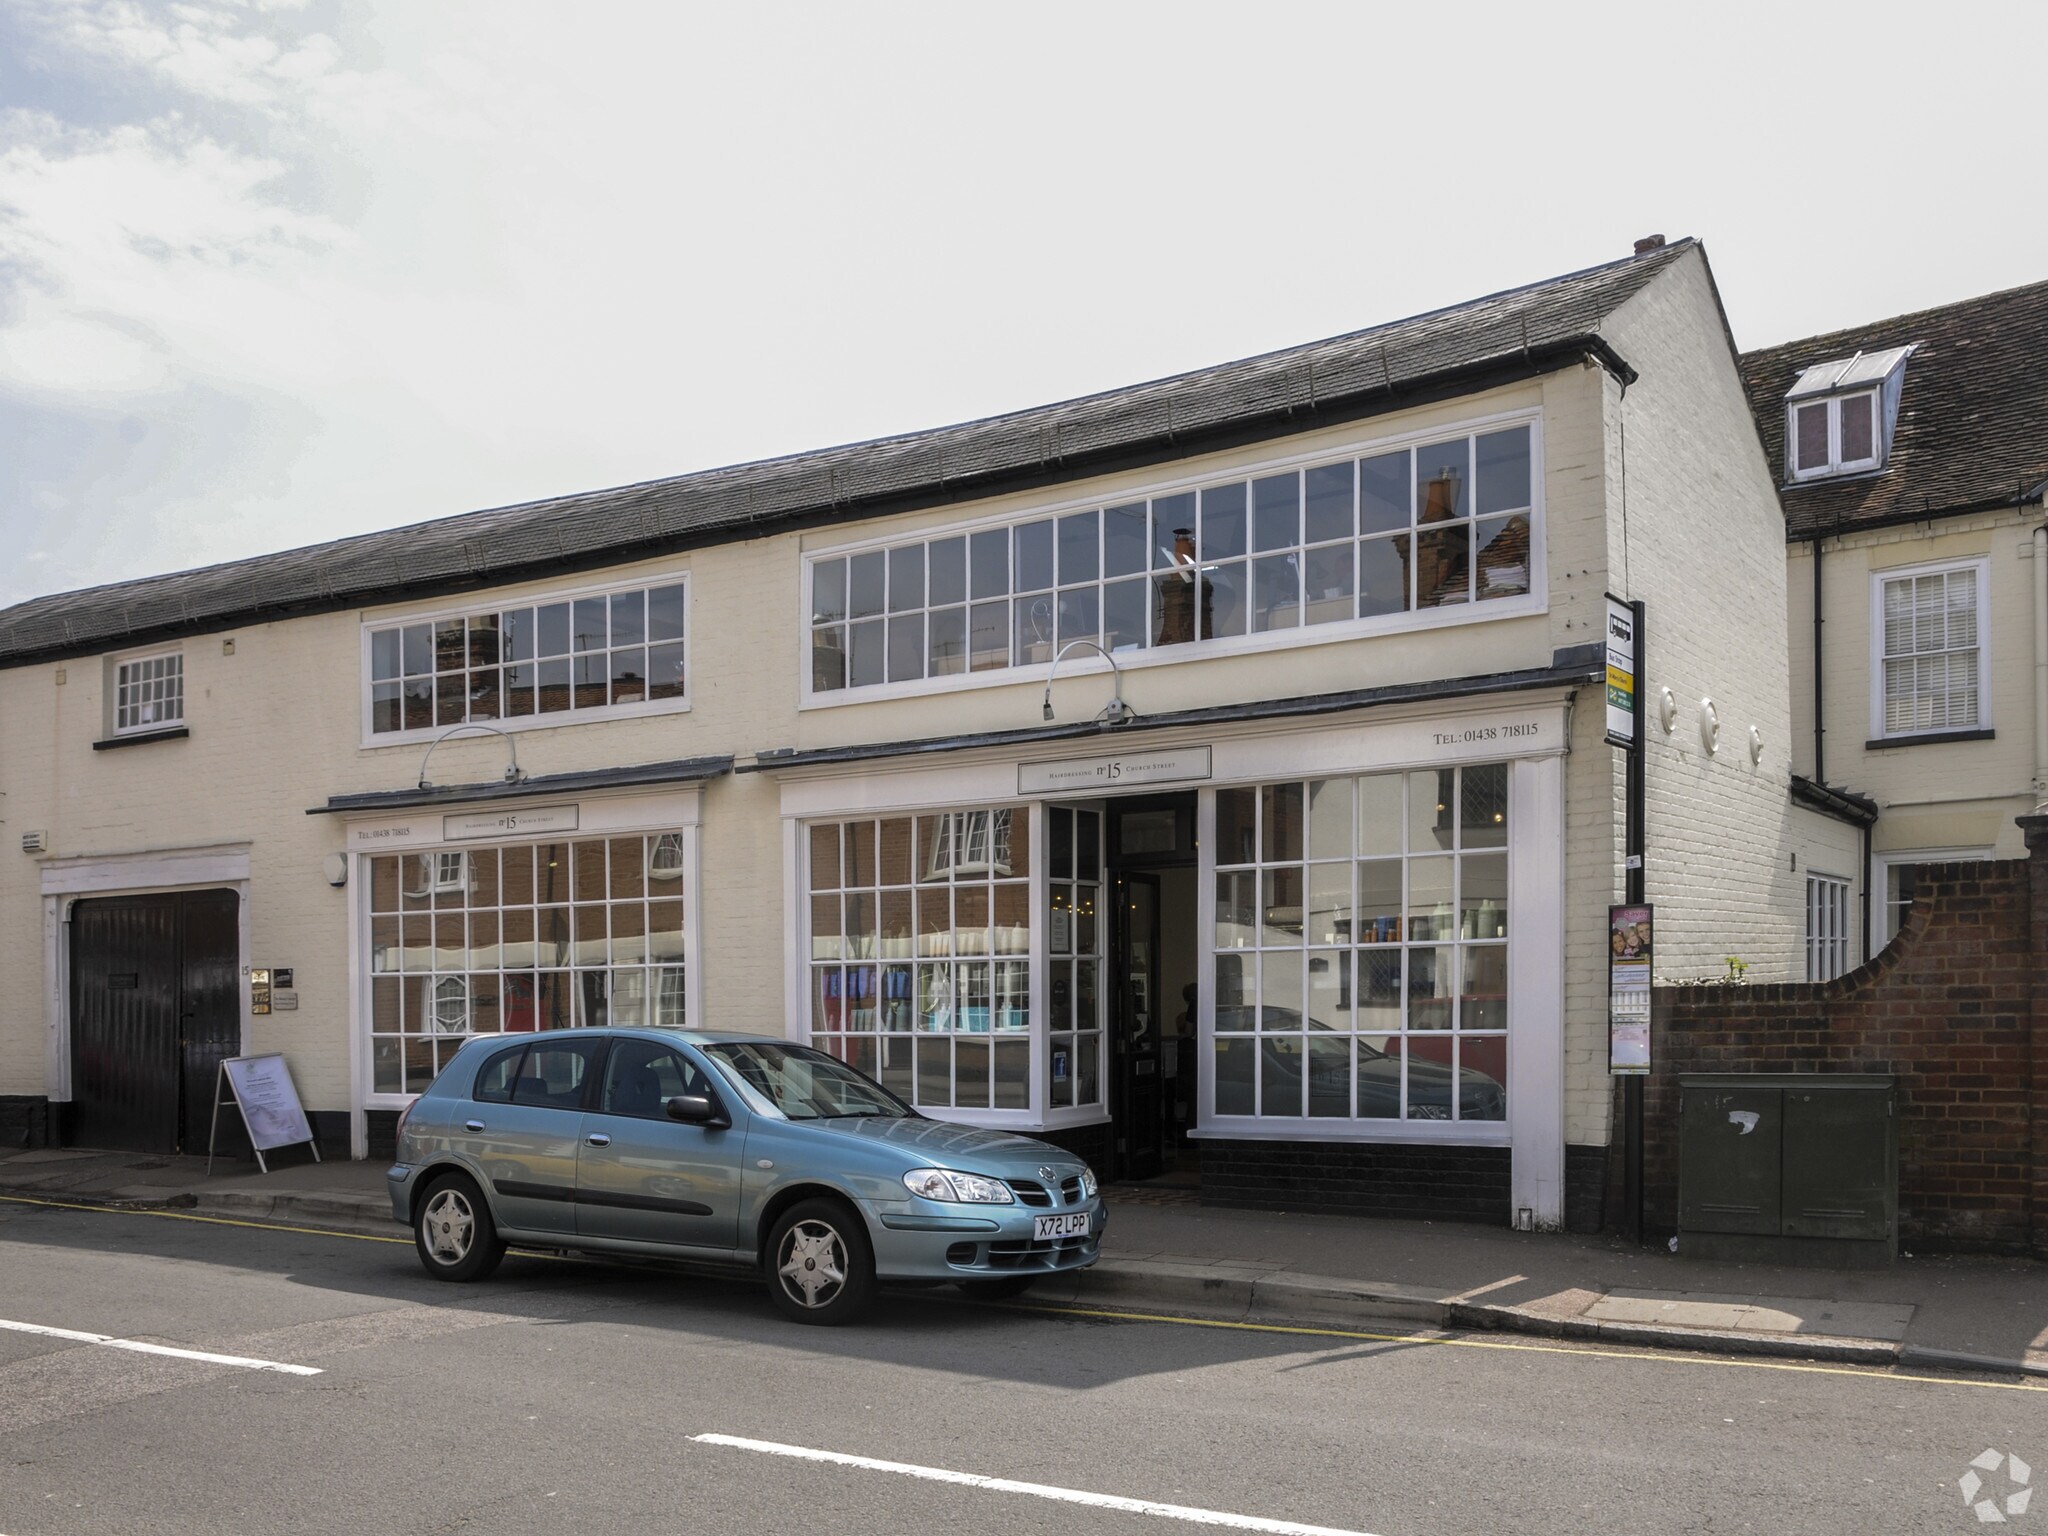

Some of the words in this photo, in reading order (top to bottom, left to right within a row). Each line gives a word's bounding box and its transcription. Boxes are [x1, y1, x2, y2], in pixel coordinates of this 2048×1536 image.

[1464, 727, 1497, 742] 01438
[1501, 723, 1538, 738] 718115
[1049, 770, 1093, 779] HAIRDRESSING
[1126, 764, 1151, 772] CHURCH
[1152, 762, 1176, 770] STREET
[241, 965, 249, 976] 15
[1040, 1217, 1063, 1237] X72
[1065, 1214, 1085, 1234] LPP
